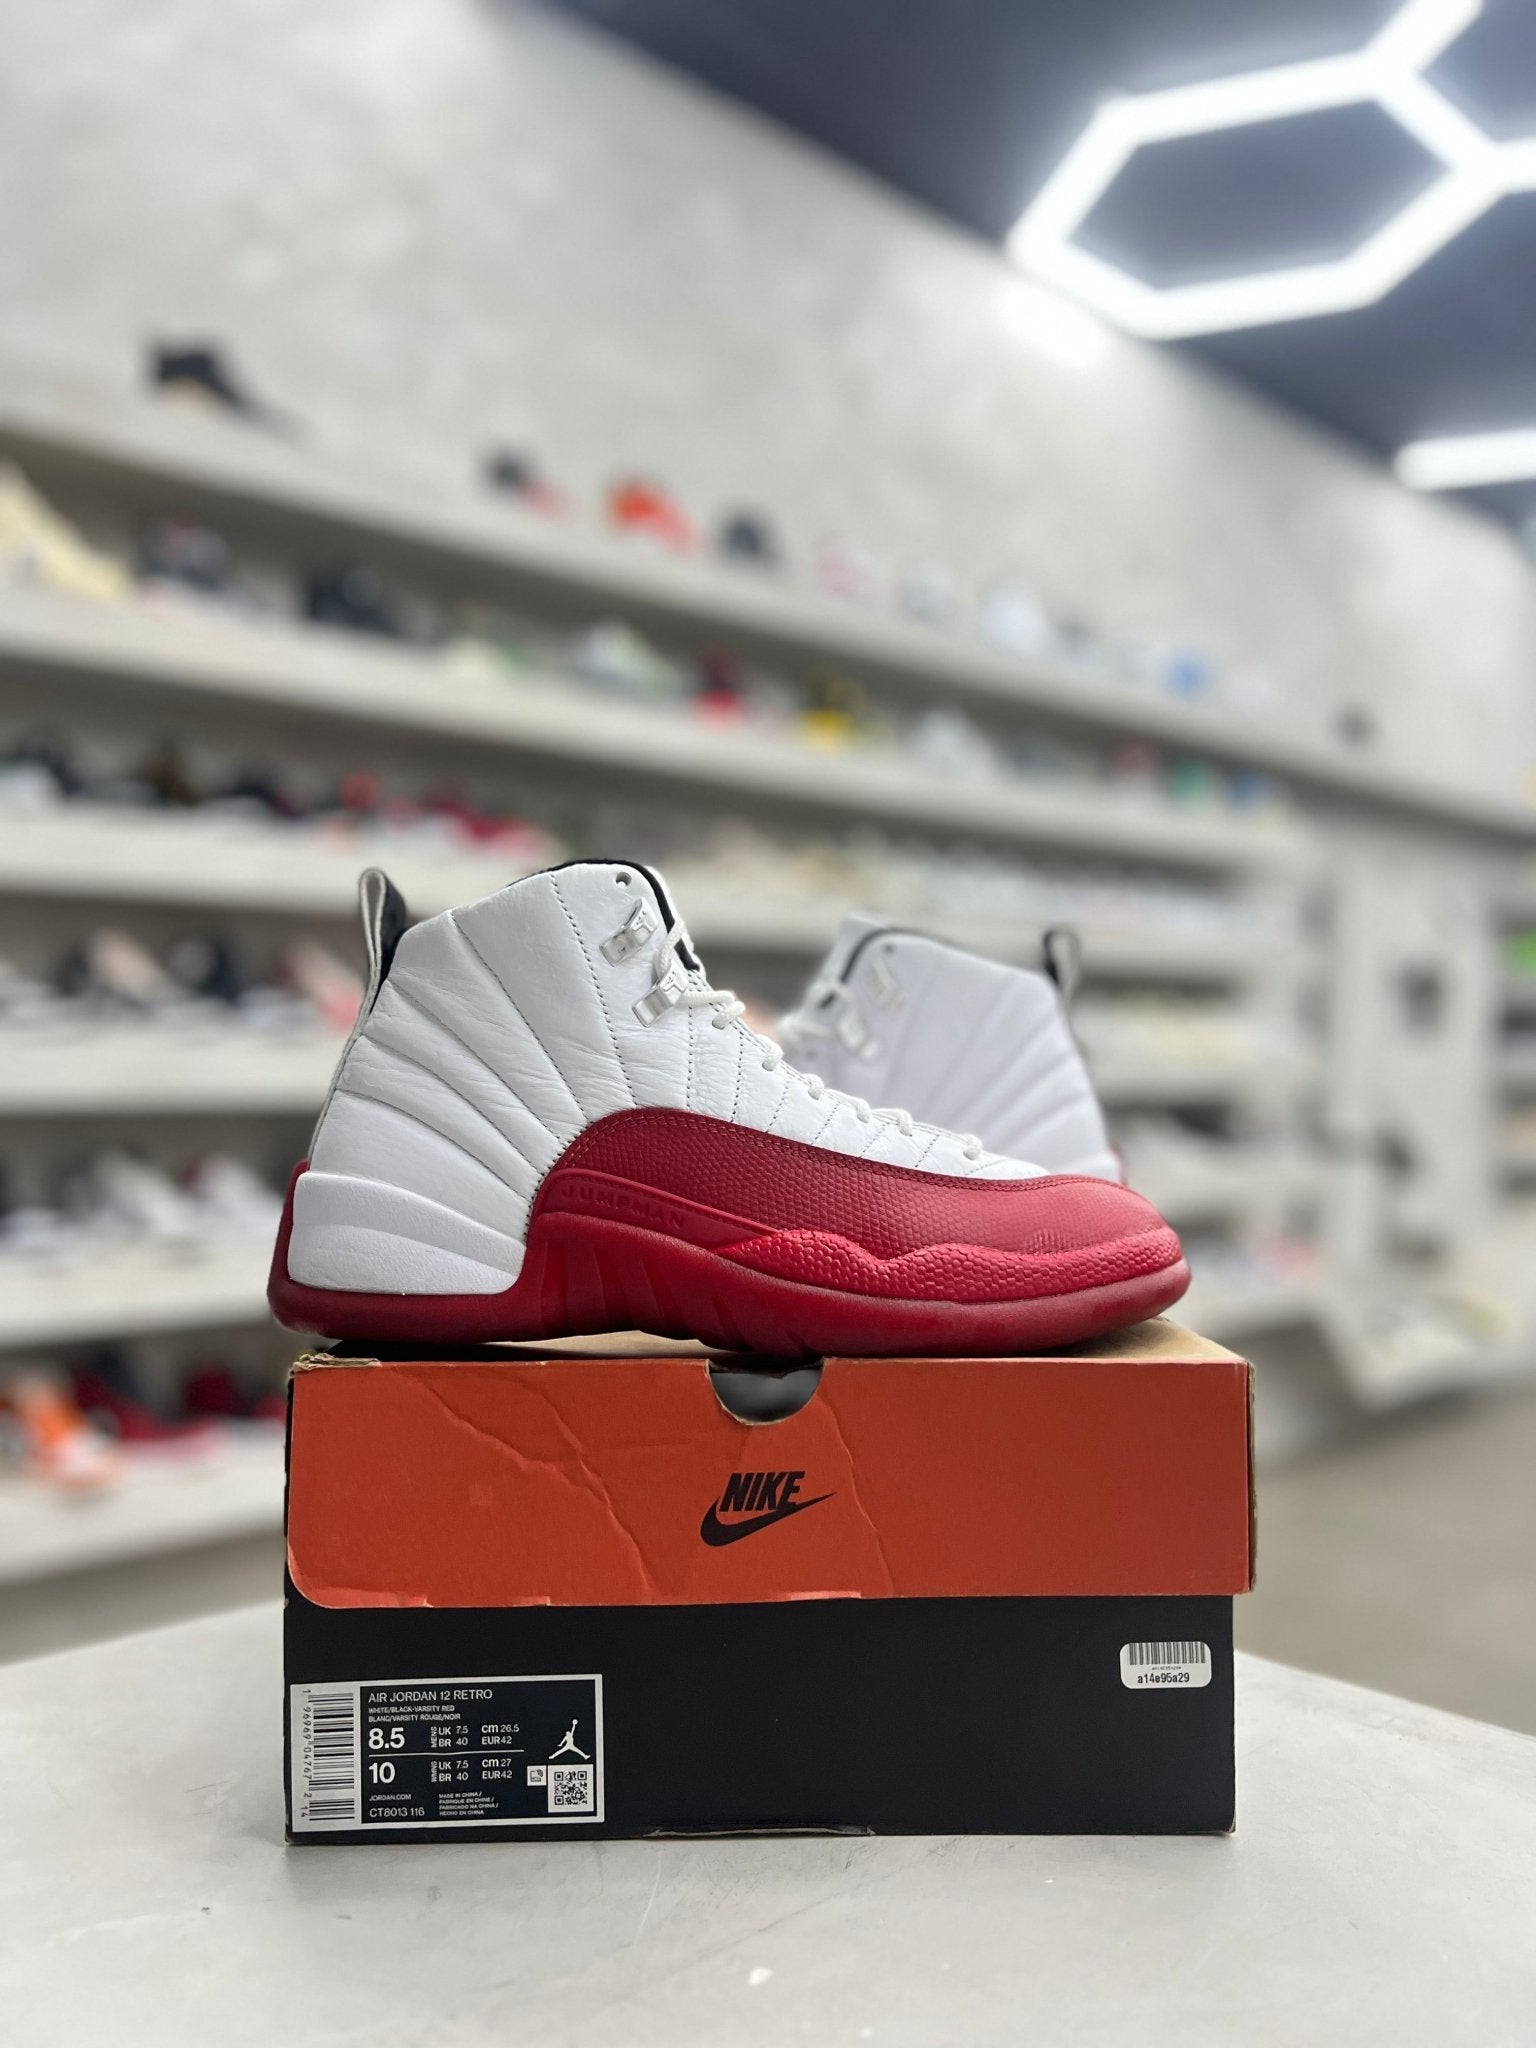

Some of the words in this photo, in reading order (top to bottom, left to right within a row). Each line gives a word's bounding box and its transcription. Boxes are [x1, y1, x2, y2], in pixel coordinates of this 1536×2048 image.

[719, 1471, 805, 1512] NIKE
[1137, 1672, 1190, 1684] a14e95a29
[368, 1692, 387, 1703] AIR
[390, 1690, 436, 1702] JORDAN
[440, 1690, 450, 1700] 12
[454, 1689, 493, 1700] RETRO
[441, 1704, 455, 1712] RED
[438, 1726, 451, 1735] UK
[456, 1726, 468, 1734] 7.5
[481, 1724, 498, 1733] cm
[500, 1724, 519, 1732] 26.5
[368, 1727, 405, 1749] 8.5
[438, 1738, 451, 1747] BR
[456, 1737, 468, 1746] 40
[481, 1736, 500, 1745] EUR
[500, 1736, 512, 1744] 42
[438, 1761, 451, 1770] UK
[456, 1760, 469, 1768] 7.5
[482, 1759, 499, 1767] cm
[500, 1758, 512, 1766] 27
[369, 1761, 396, 1784] 10
[438, 1773, 451, 1782] BR
[456, 1772, 468, 1781] 40
[482, 1771, 500, 1779] EUR
[500, 1770, 512, 1779] 42
[369, 1794, 412, 1802] JORDAN.COM
[369, 1808, 408, 1818] CT8013
[410, 1807, 425, 1816] 116
